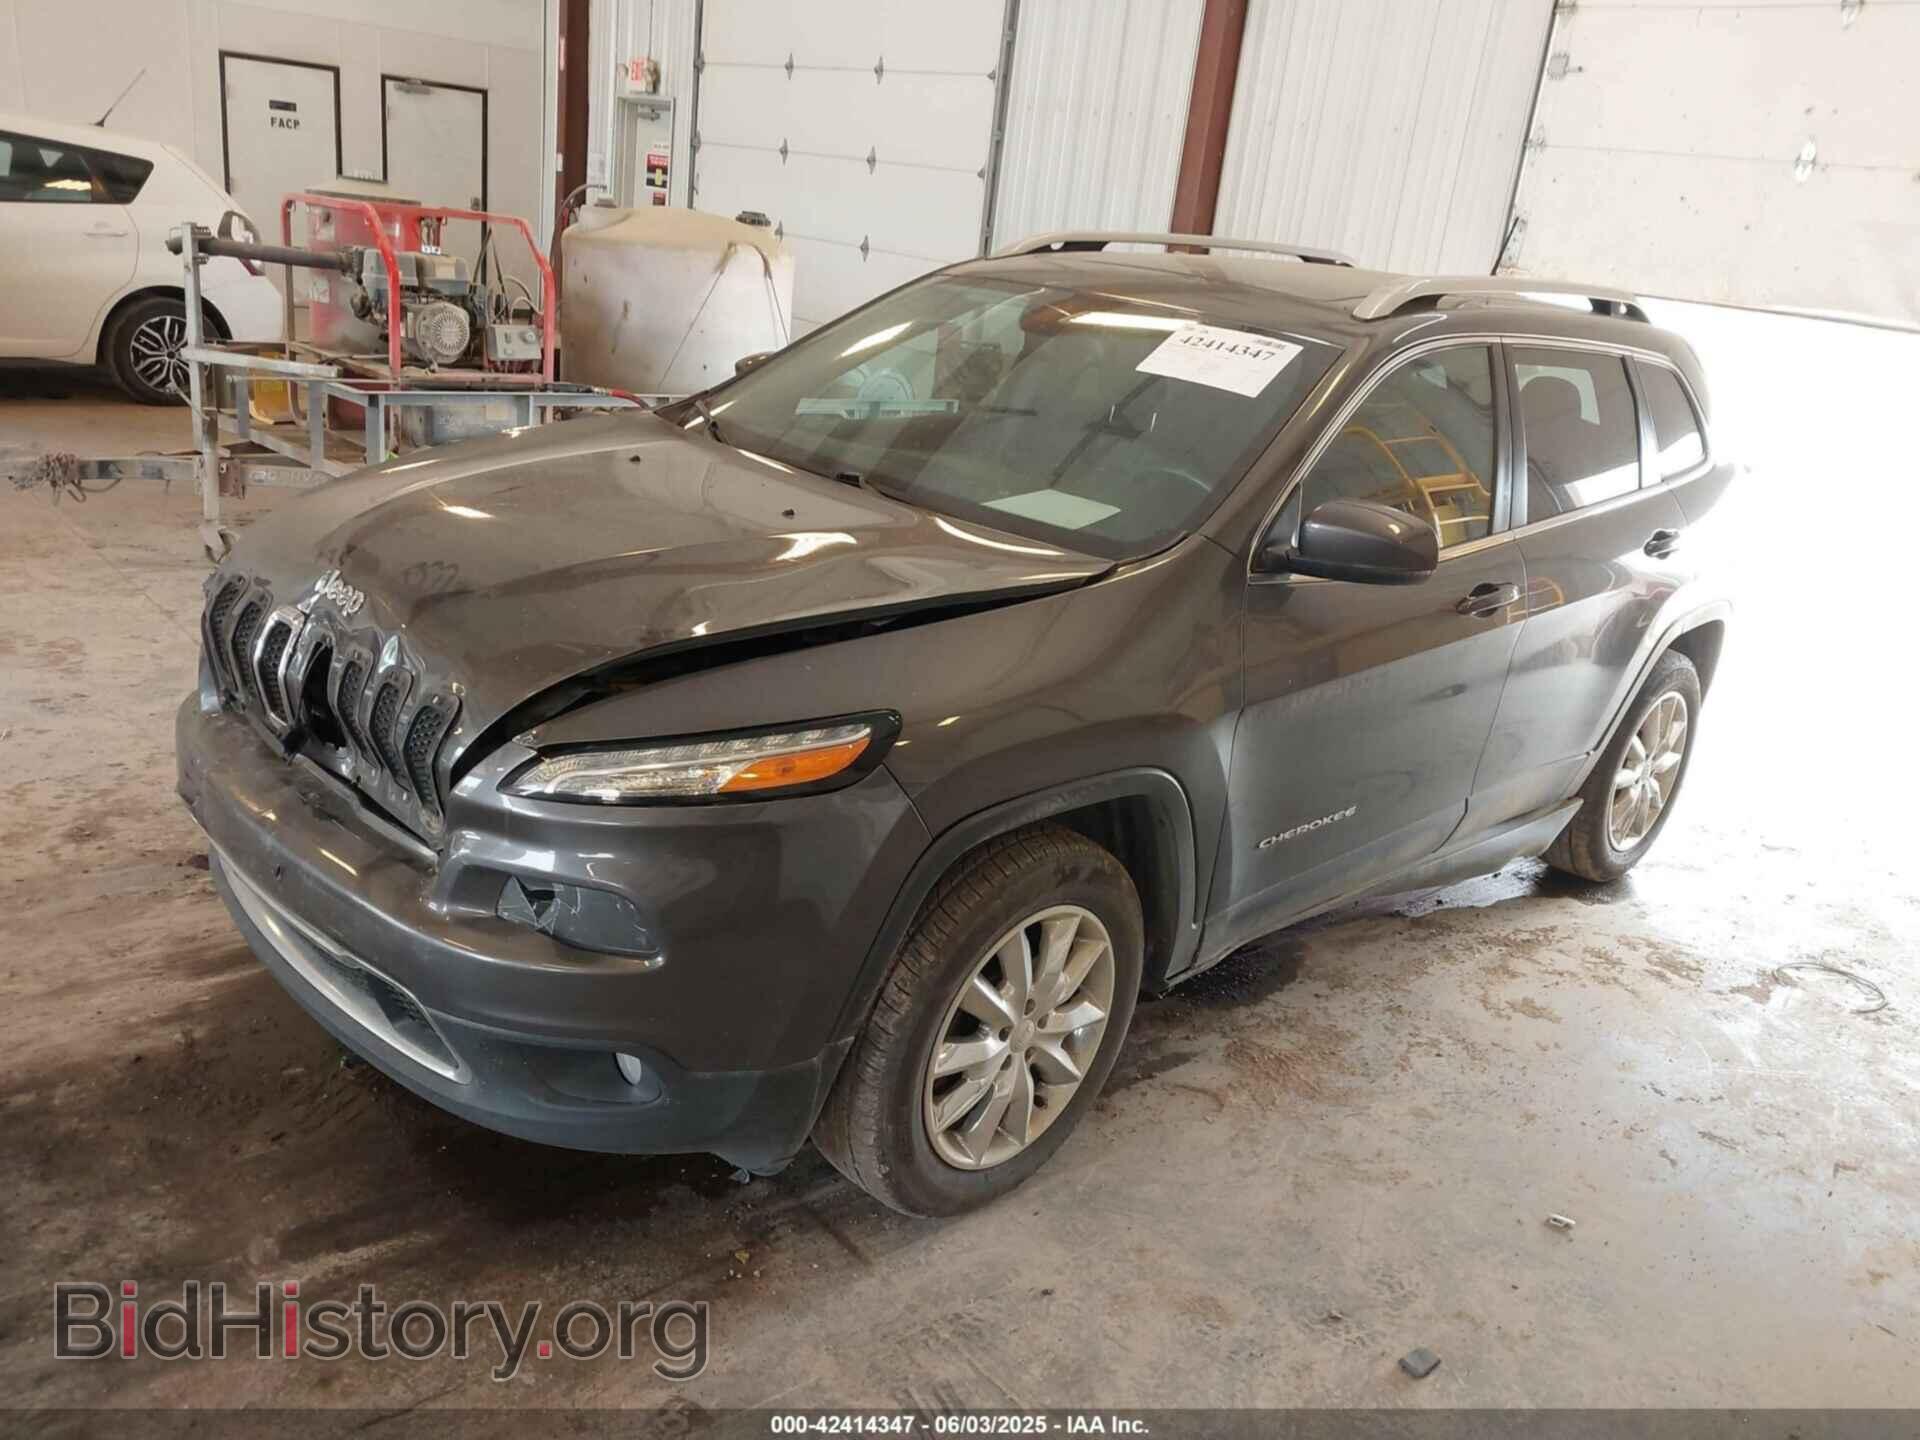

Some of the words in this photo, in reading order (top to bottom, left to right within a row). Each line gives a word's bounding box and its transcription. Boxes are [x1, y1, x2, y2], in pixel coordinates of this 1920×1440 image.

[270, 116, 300, 130] FACP
[1180, 335, 1276, 361] 42414347
[314, 569, 365, 617] Jeep
[1259, 805, 1357, 849] CHEROKEE
